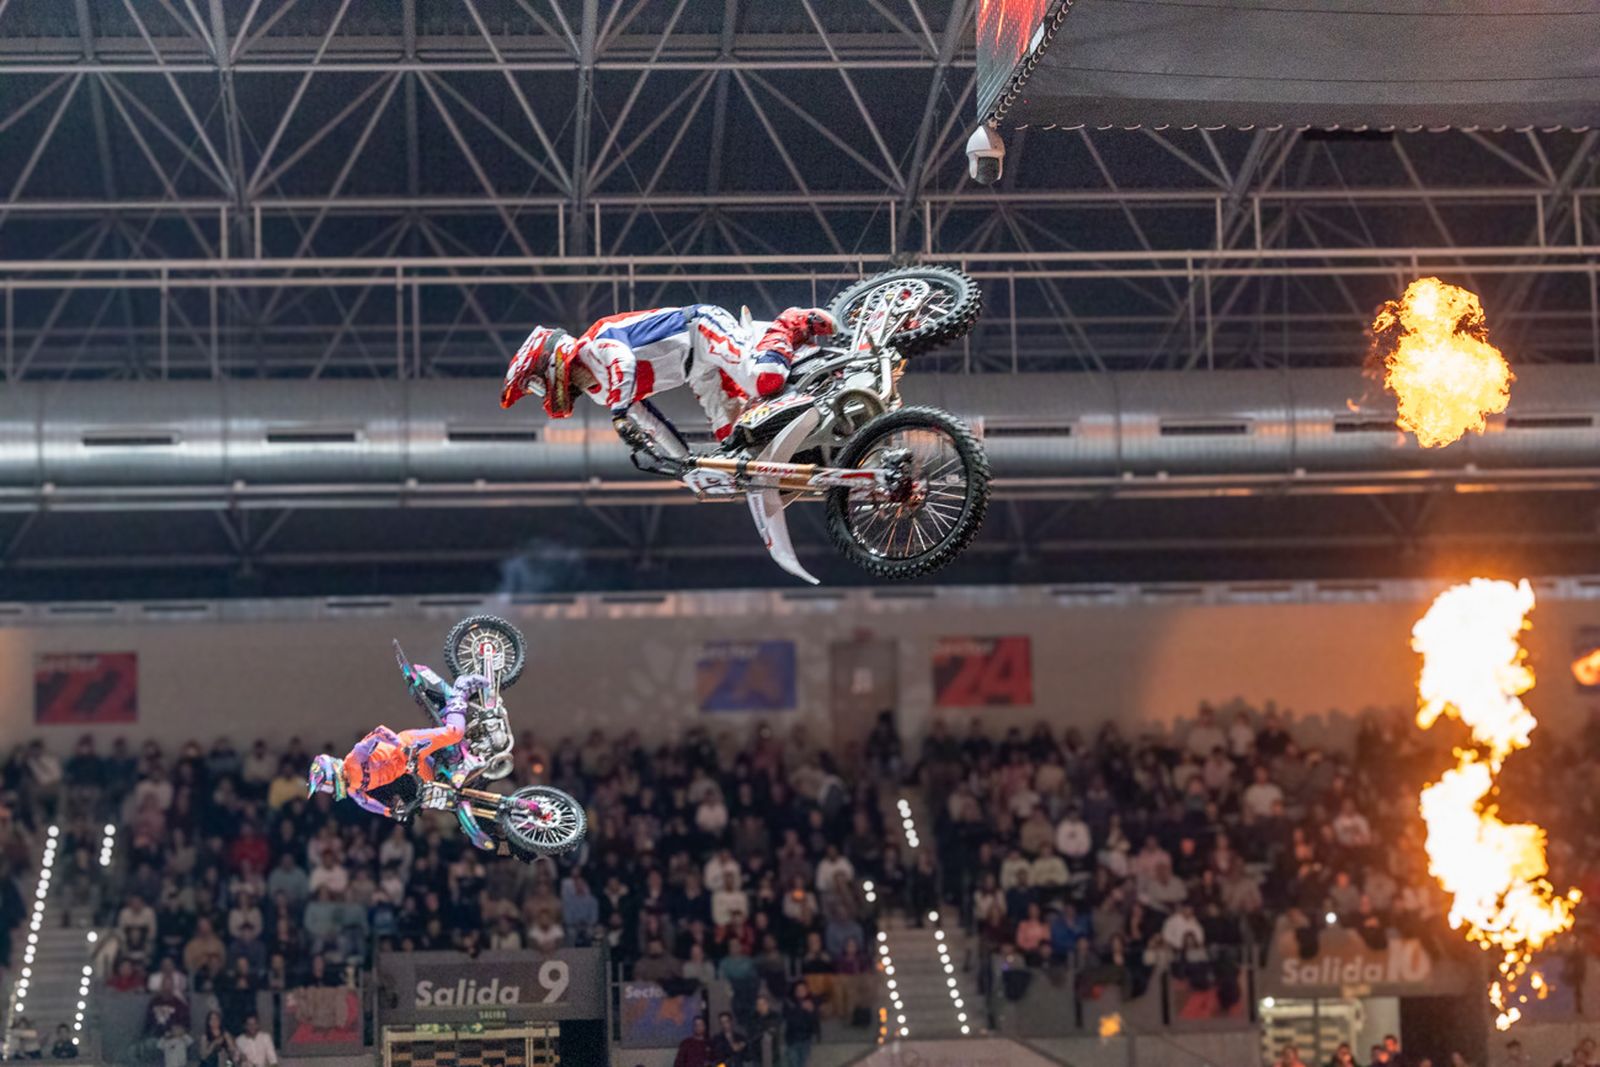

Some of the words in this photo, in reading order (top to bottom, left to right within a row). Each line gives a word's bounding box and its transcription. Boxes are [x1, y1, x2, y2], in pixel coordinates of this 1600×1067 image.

[415, 978, 520, 1006] Salida
[538, 960, 570, 1003] 9
[1281, 957, 1382, 984] Salida
[625, 985, 664, 999] Secto
